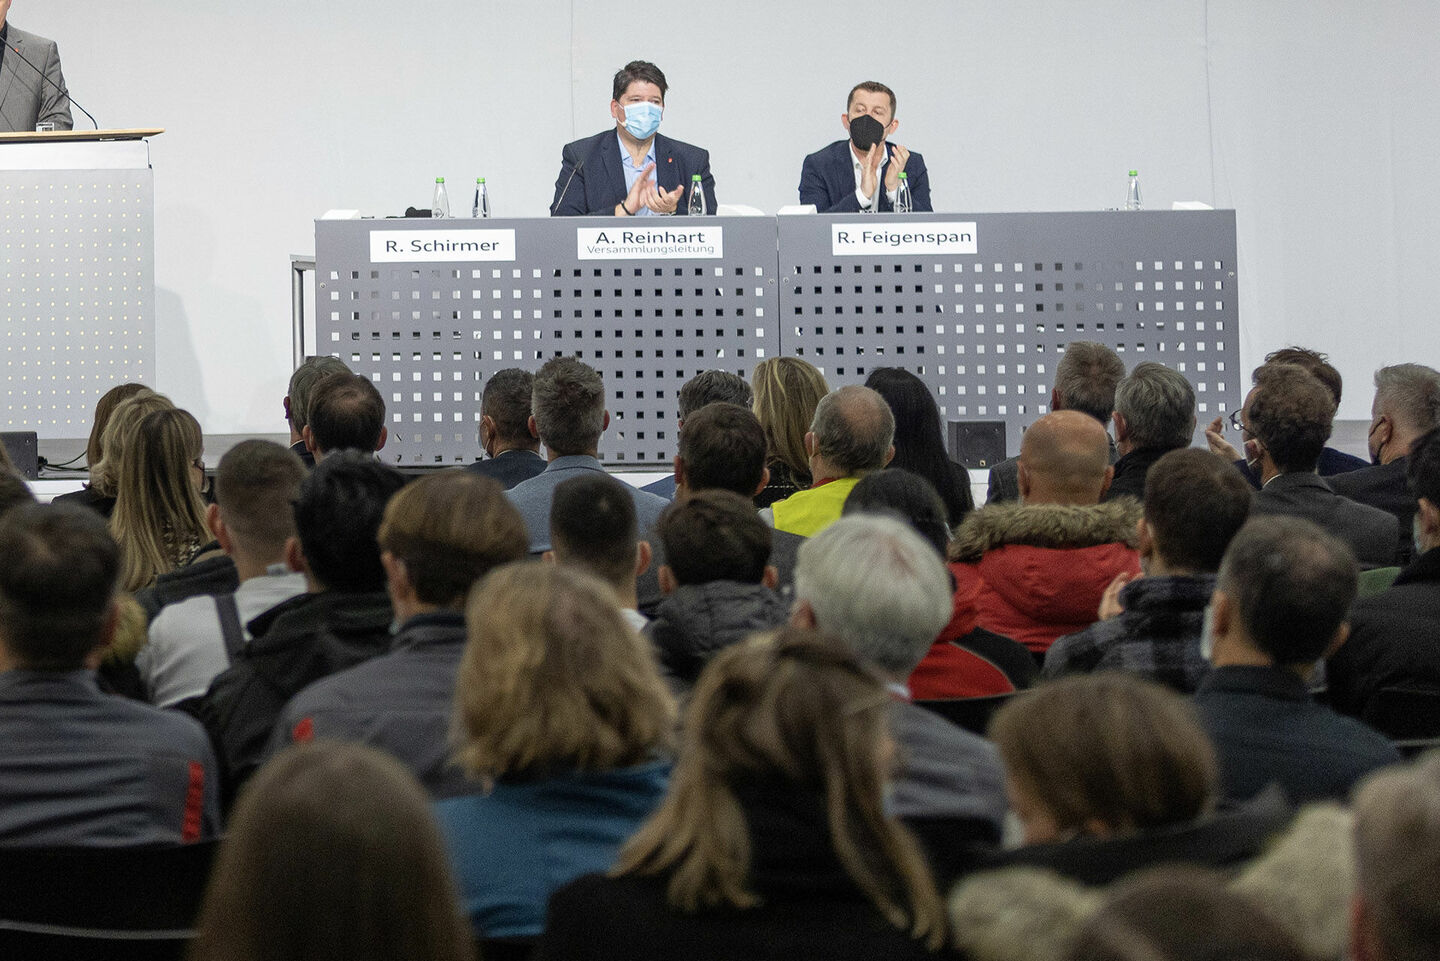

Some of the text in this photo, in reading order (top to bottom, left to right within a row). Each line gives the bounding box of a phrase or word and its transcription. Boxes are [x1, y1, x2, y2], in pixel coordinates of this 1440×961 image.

[596, 231, 705, 244] A. Reinhart
[838, 231, 972, 247] R. Feigenspan
[386, 239, 500, 253] R. Schirmer
[587, 245, 715, 255] Versammlungsleitung
